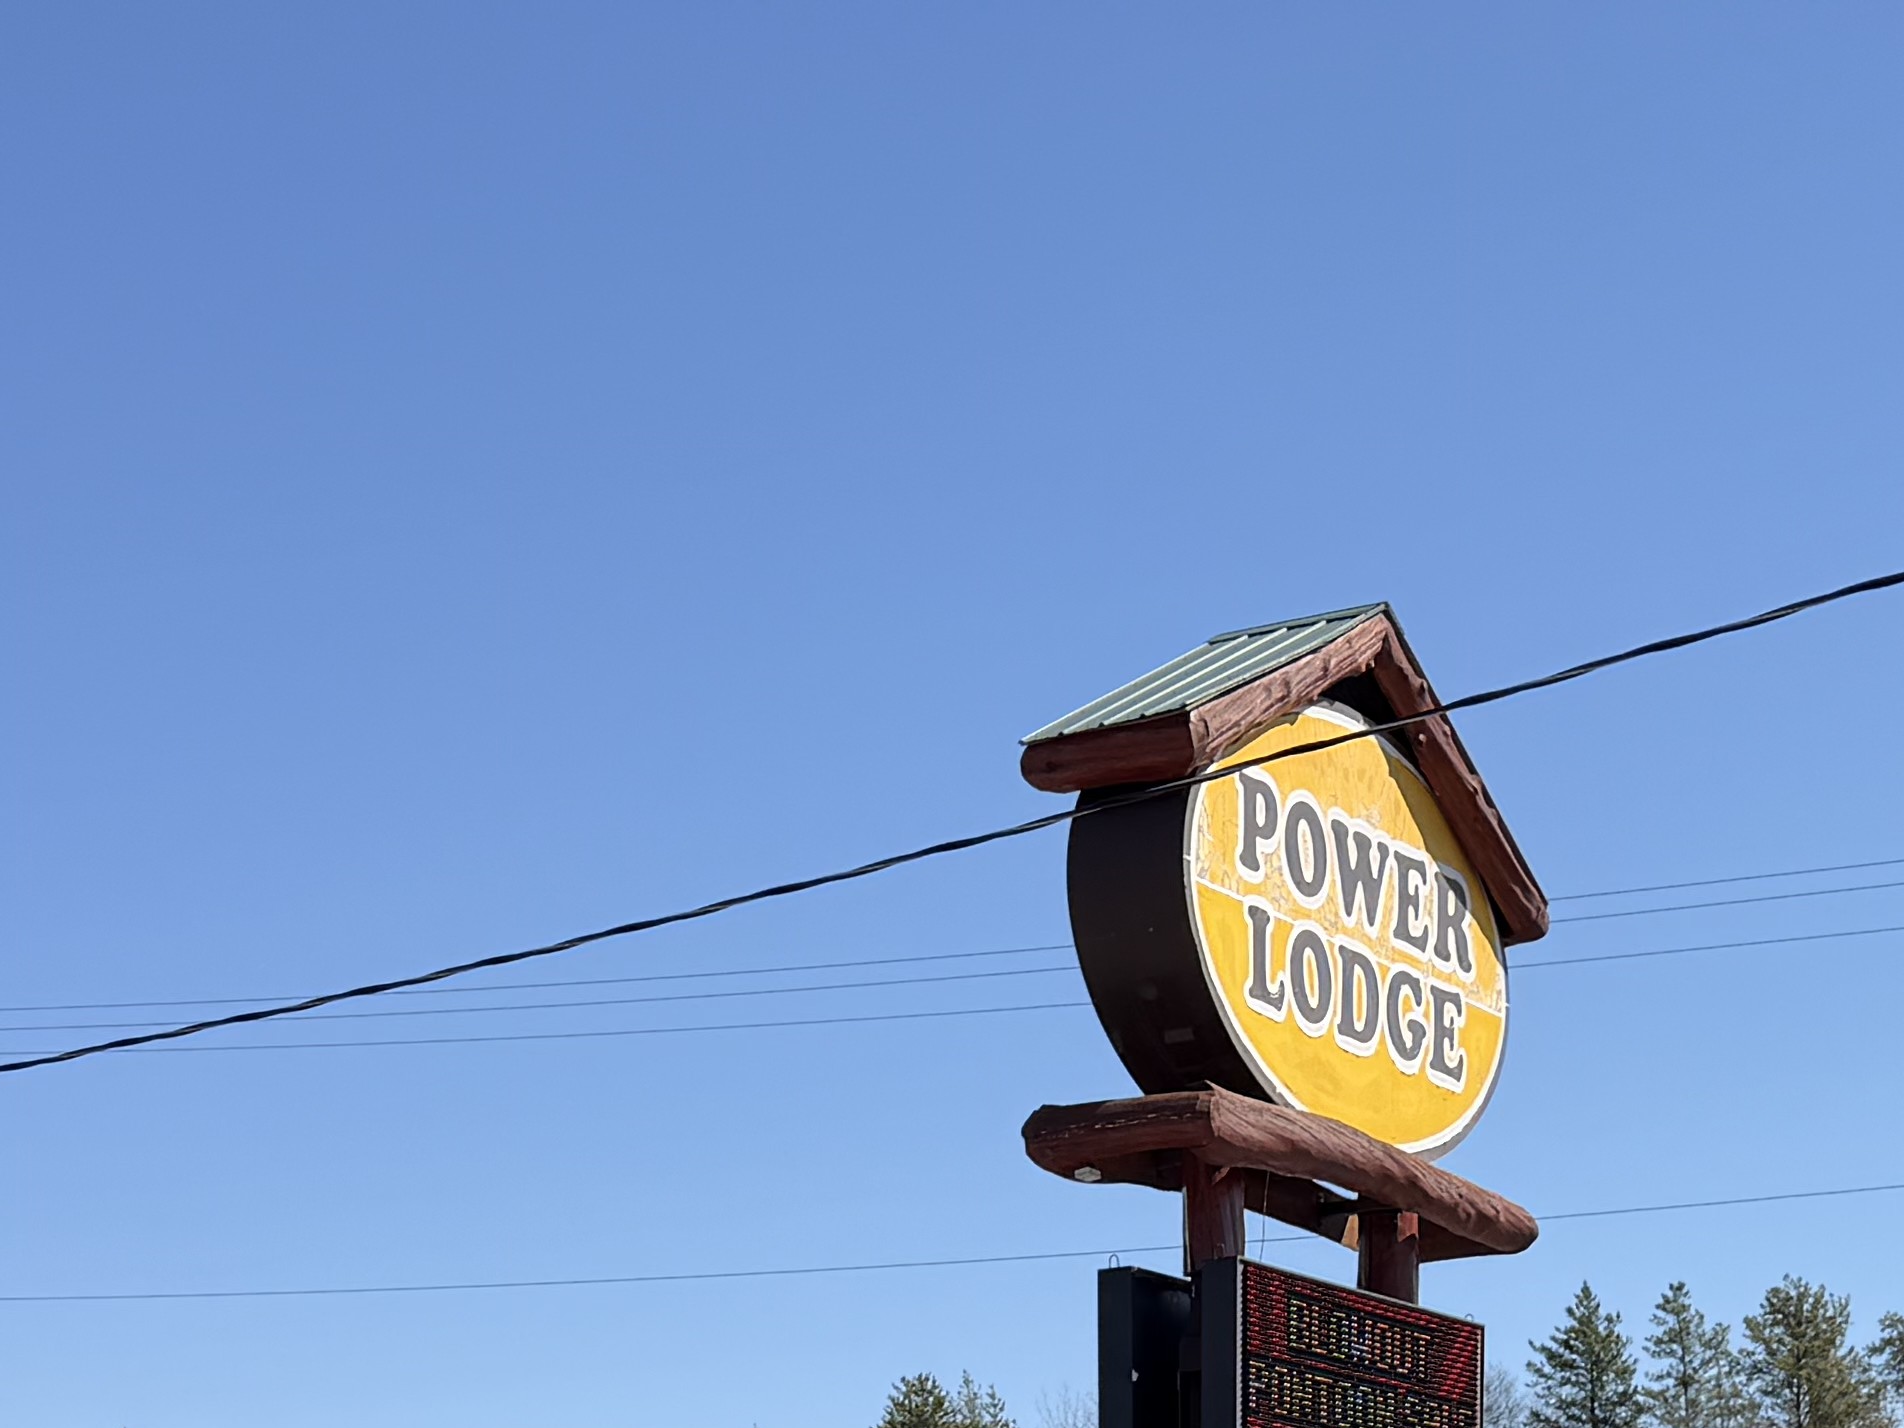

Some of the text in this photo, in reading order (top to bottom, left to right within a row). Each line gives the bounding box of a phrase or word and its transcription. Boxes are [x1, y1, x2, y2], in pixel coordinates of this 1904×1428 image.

[1237, 770, 1473, 975] POWER
[1247, 903, 1465, 1085] LODGE
[1289, 1298, 1432, 1379] BLOWOUT
